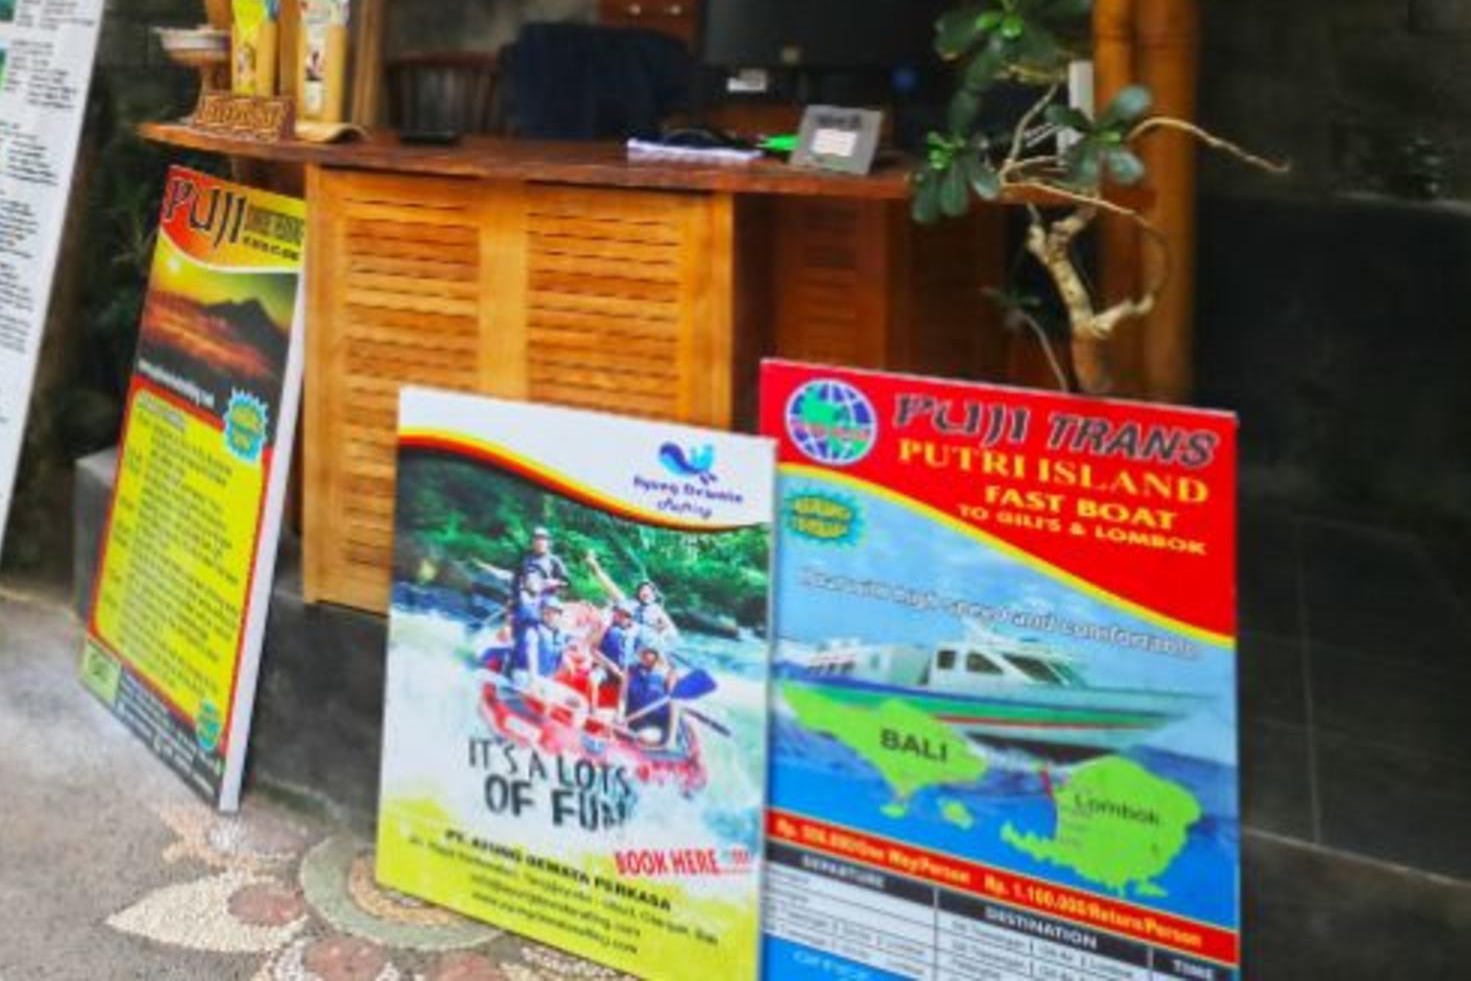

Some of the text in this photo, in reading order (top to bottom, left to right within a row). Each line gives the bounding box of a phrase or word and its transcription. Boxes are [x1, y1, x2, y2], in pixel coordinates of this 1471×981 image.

[893, 393, 1221, 469] PUJI TRANS
[899, 439, 1209, 504] PUTRI ISLAND
[957, 503, 989, 521] TO
[1069, 521, 1086, 537] &
[1093, 524, 1208, 557] LOMBOK
[984, 485, 1177, 530] FAST BOAT
[879, 727, 949, 763] BALI
[528, 750, 548, 780] A
[555, 753, 632, 798] LOTS
[484, 773, 628, 832] OF FUN
[615, 850, 666, 877] BOOK
[670, 848, 720, 876] HERE
[984, 905, 1099, 951] DESTINATION
